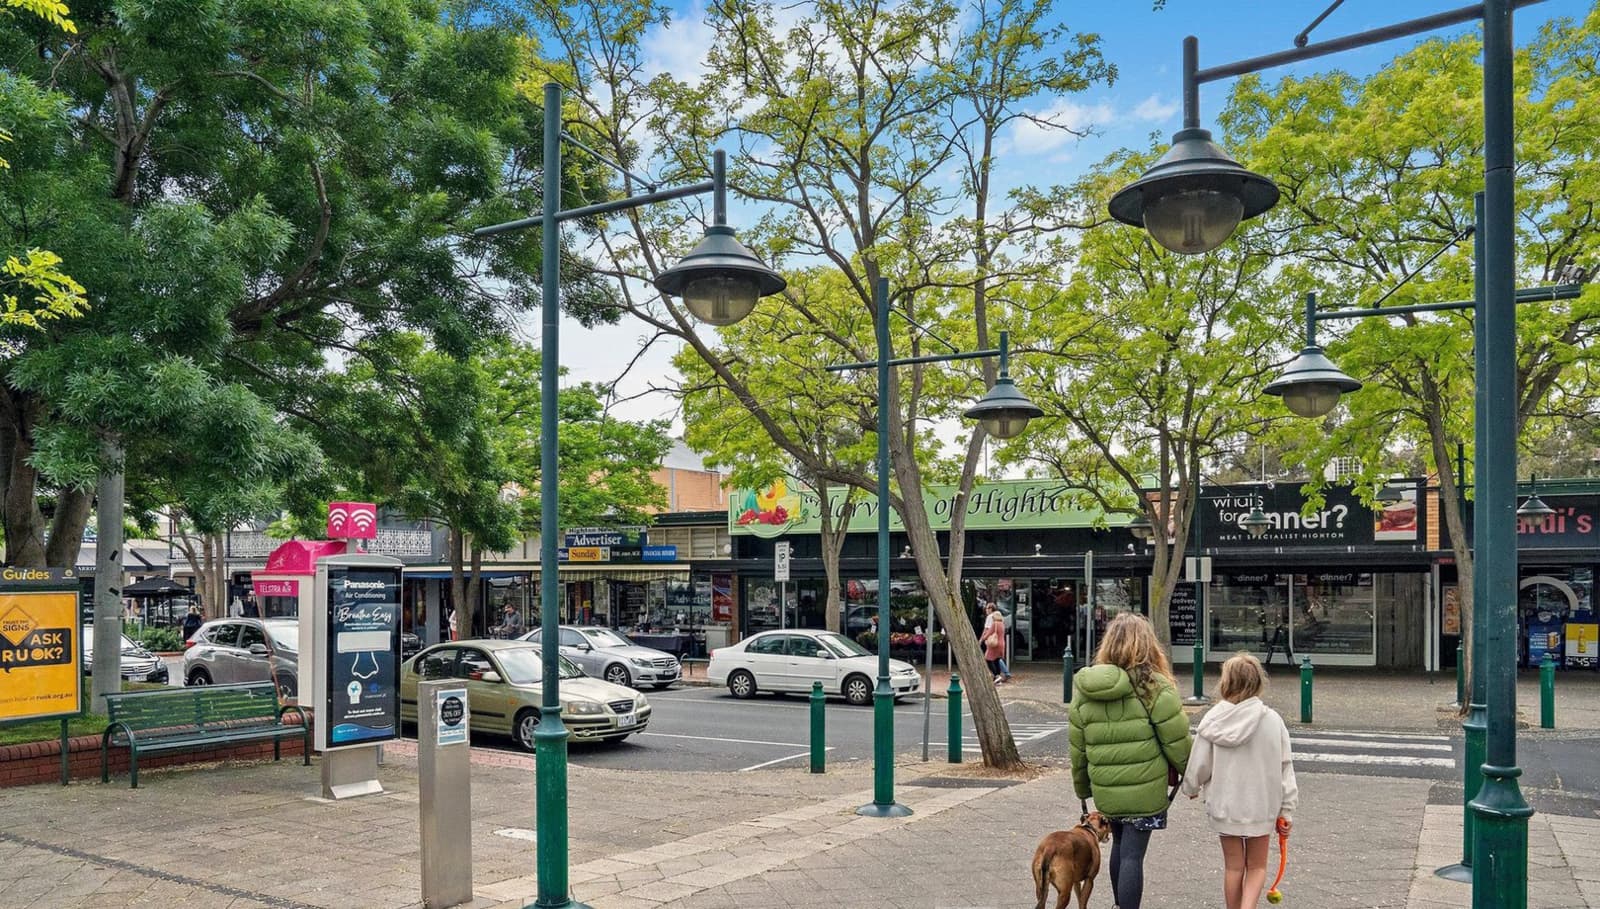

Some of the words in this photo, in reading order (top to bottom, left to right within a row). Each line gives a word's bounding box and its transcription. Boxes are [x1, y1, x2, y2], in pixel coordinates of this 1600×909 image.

[1219, 508, 1239, 522] for
[573, 534, 622, 547] Advertiser
[1246, 532, 1299, 540] SPECIALIST
[571, 550, 598, 560] Sunday
[2, 569, 50, 581] Guides
[259, 584, 281, 593] TELSTRA
[344, 579, 385, 589] Panasonic
[345, 591, 353, 599] Air
[354, 591, 386, 601] Conditioning
[3, 623, 30, 632] SIGNS
[31, 632, 63, 646] ASK
[2, 650, 14, 662] R
[16, 649, 29, 662] U
[31, 647, 64, 661] OK?
